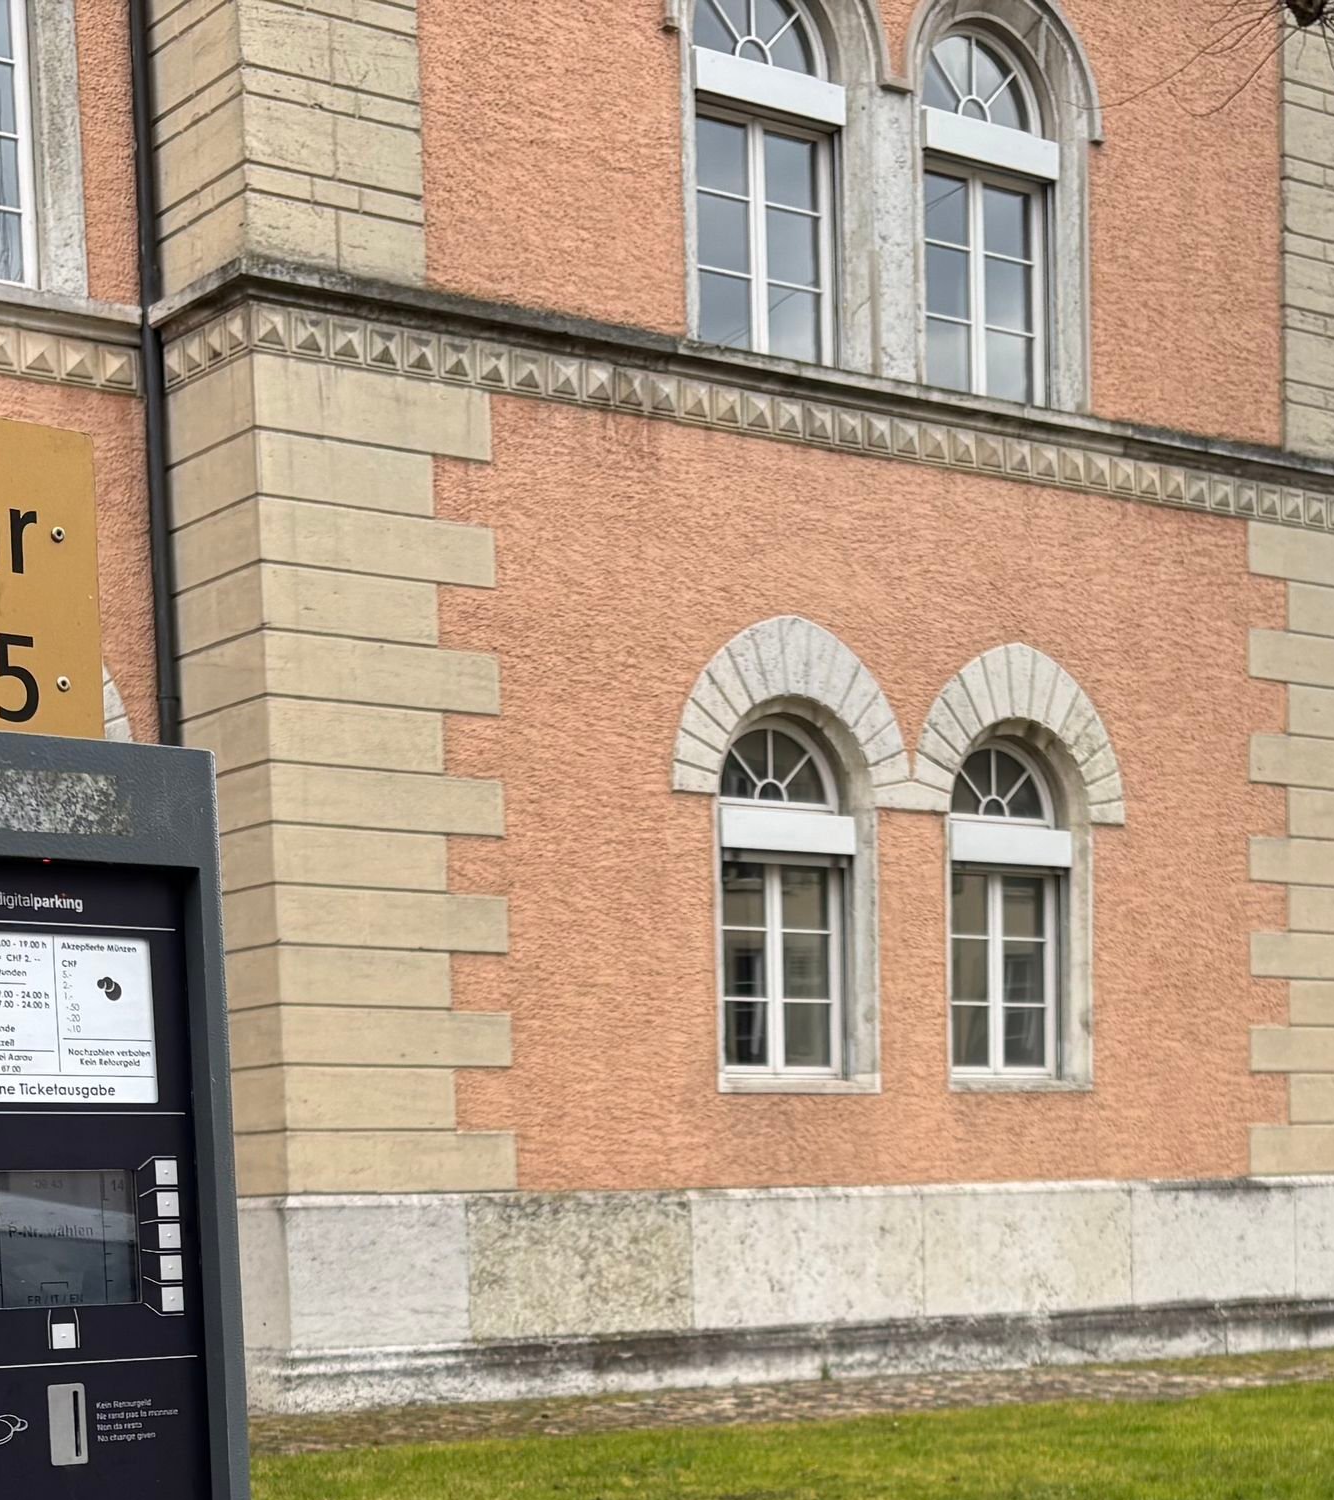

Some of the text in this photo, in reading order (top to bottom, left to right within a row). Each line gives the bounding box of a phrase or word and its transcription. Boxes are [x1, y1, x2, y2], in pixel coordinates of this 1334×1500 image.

[61, 942, 137, 953] Akzeptierte Münzen
[6, 954, 22, 962] CHF
[61, 960, 77, 968] CHF
[68, 1048, 150, 1057] Nachzahlen verboten
[8, 1053, 33, 1061] Aarau
[80, 1058, 96, 1066] Kein
[19, 1083, 116, 1098] Ticketausgabe
[27, 1295, 41, 1304] FR
